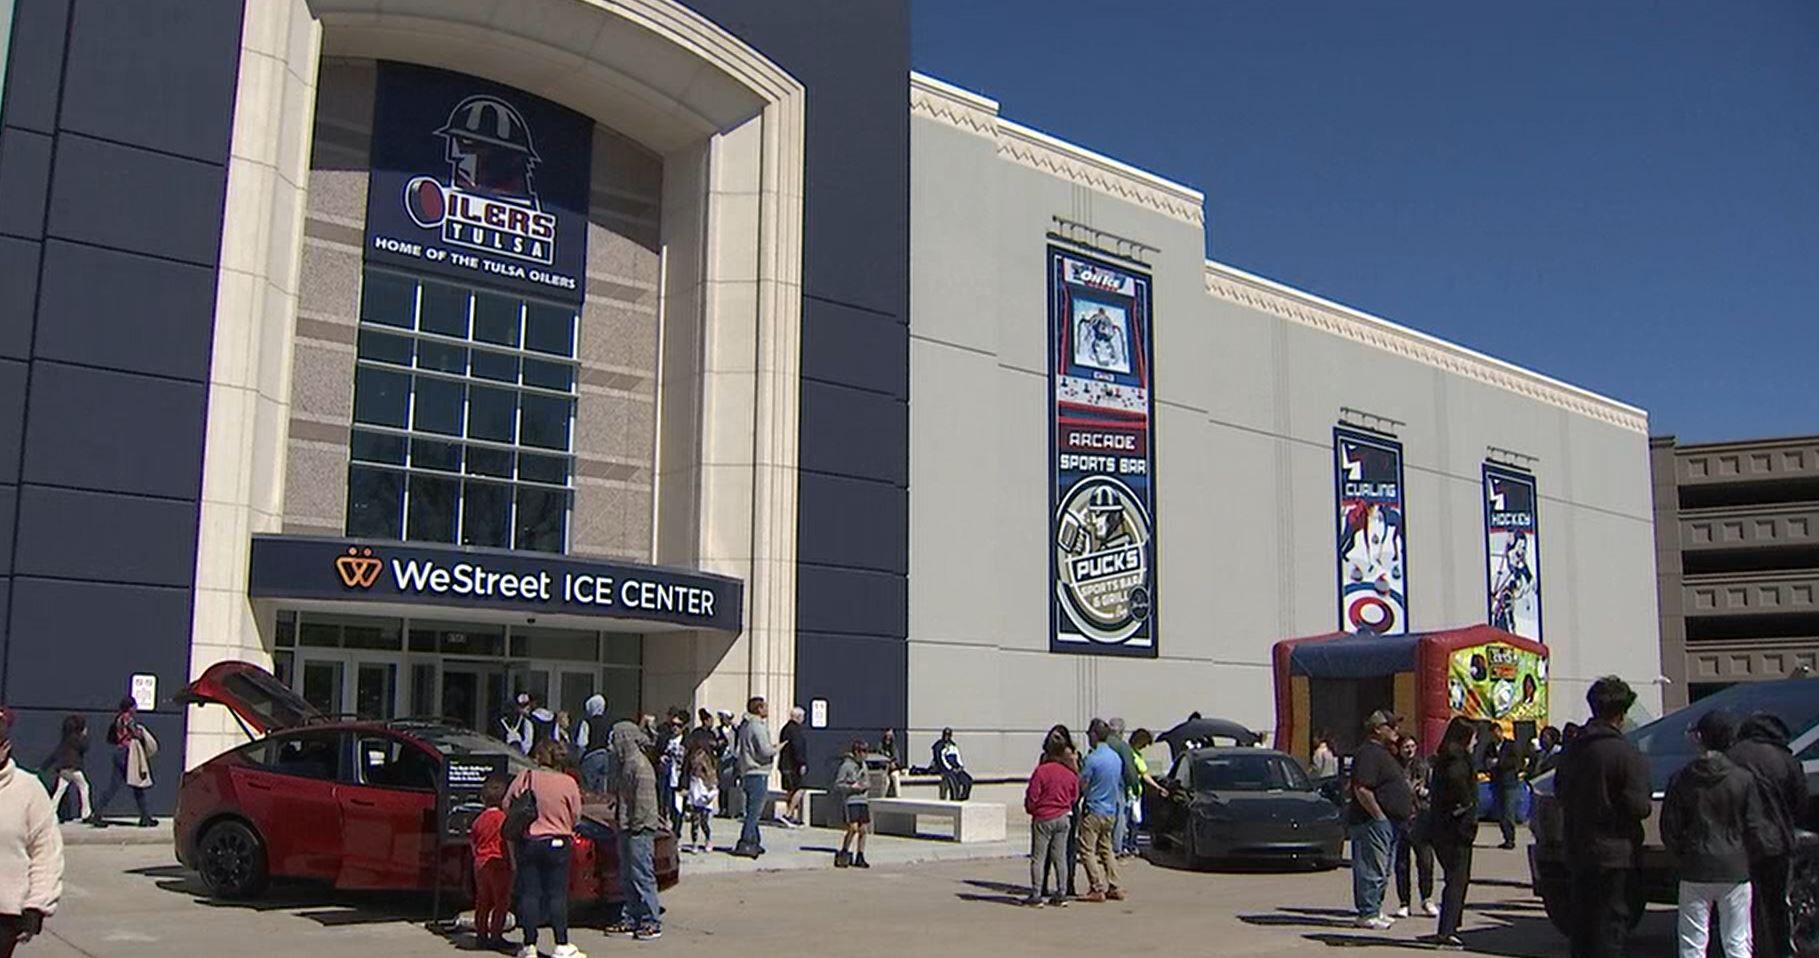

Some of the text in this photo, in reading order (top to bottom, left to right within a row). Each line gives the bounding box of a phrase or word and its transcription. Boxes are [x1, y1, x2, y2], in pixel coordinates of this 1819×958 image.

[452, 223, 542, 258] TULSA
[375, 236, 576, 289] HOME OF THE TULSA OILERS
[1069, 432, 1136, 450] ARCADE
[1060, 453, 1146, 474] SPORTS BAR
[1345, 482, 1396, 498] CURLING
[1491, 512, 1531, 526] HOCKEY
[1076, 549, 1139, 580] PUCKS
[391, 559, 714, 616] WeStreet ICE CENTER
[1081, 579, 1118, 597] SPORTS
